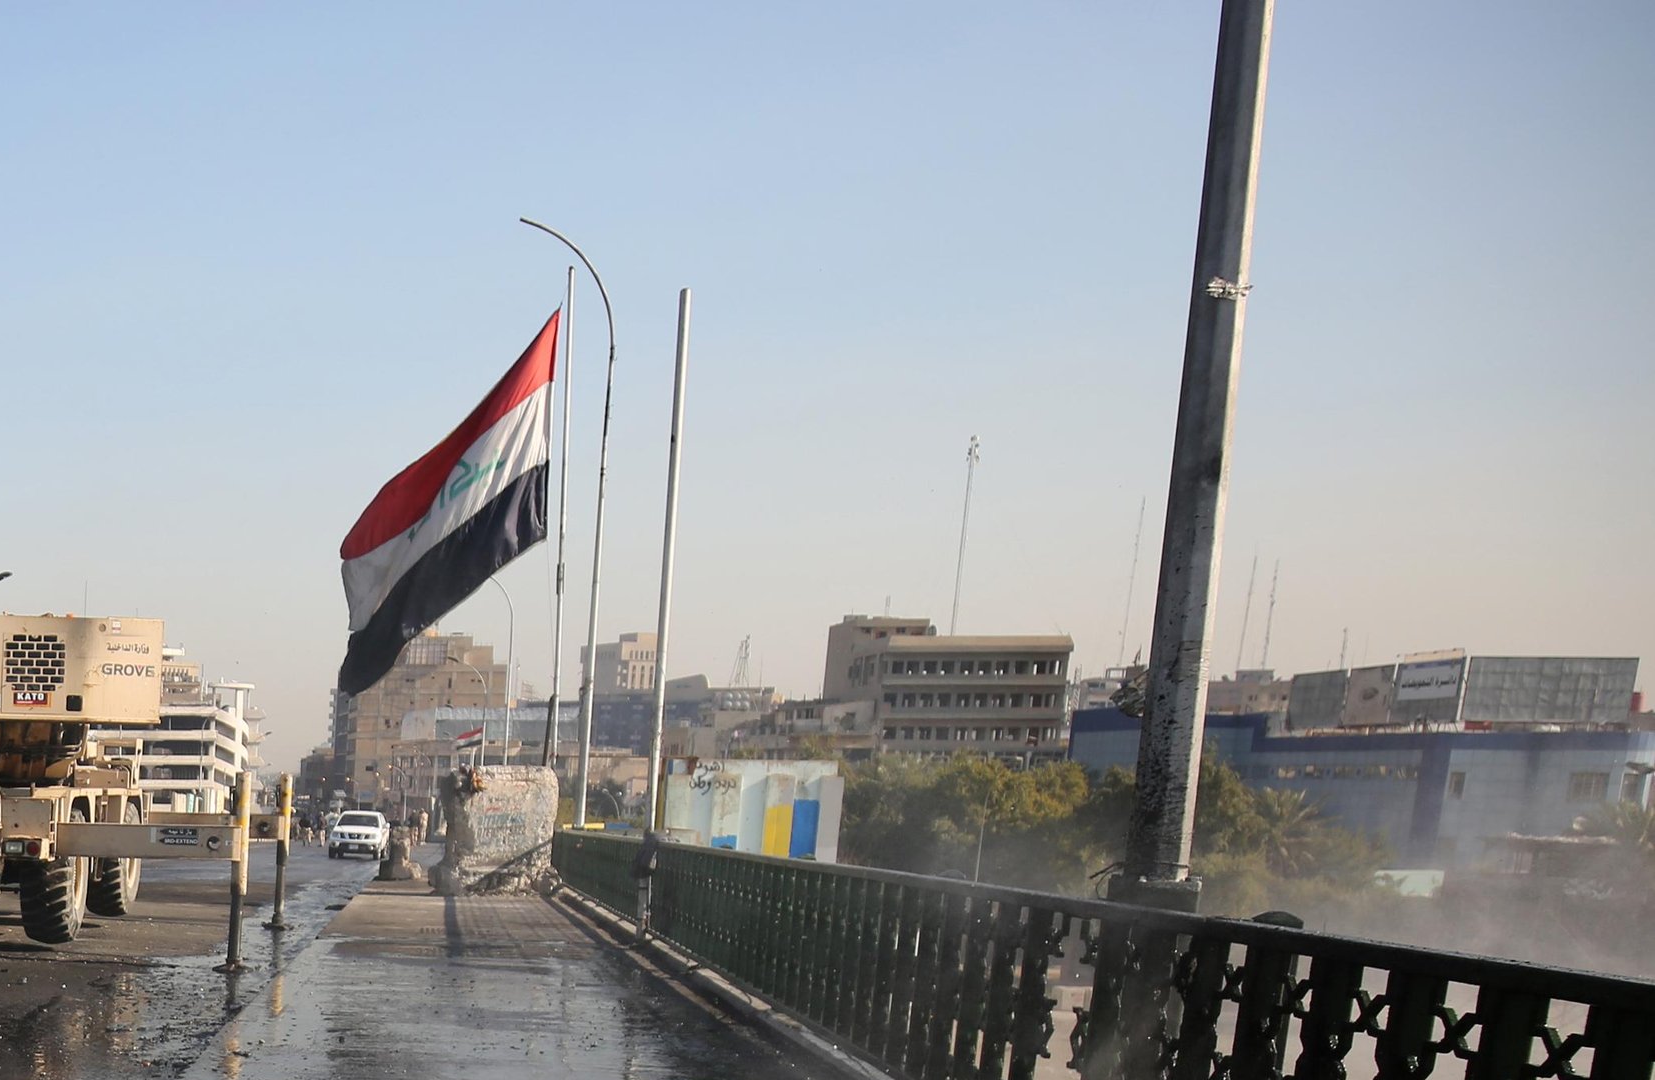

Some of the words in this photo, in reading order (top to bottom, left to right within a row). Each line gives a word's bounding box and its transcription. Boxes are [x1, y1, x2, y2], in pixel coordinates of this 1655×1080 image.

[107, 642, 134, 653] الداخلية
[134, 643, 150, 655] وزارة
[102, 663, 155, 678] GROVE
[16, 692, 45, 701] KATO
